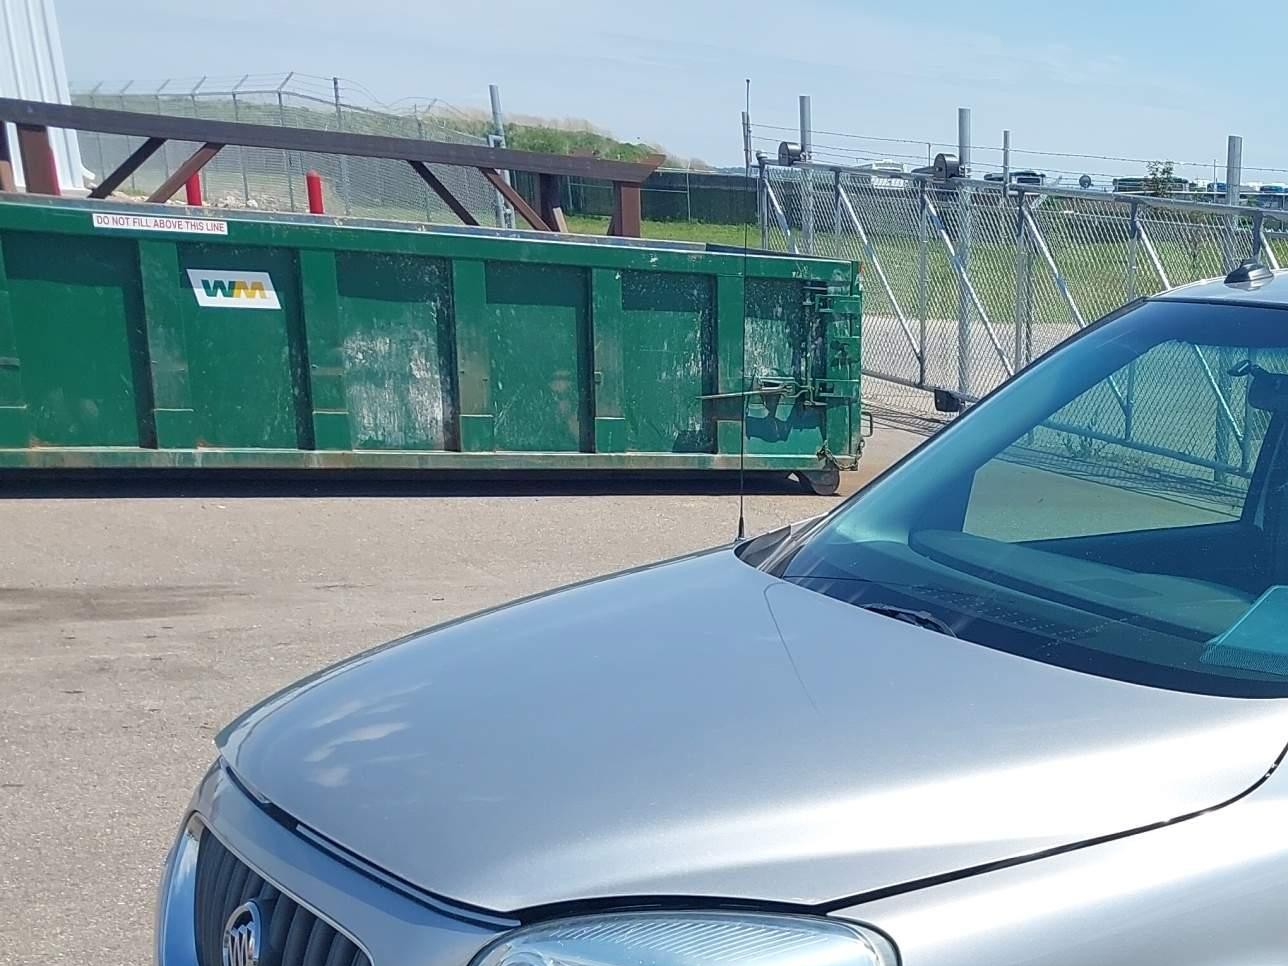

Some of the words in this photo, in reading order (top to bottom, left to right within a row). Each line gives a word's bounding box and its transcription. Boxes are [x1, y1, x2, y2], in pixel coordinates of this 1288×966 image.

[96, 215, 110, 225] DO
[112, 216, 129, 226] NOT
[133, 217, 152, 228] FILL
[153, 219, 185, 230] ABOVE
[185, 221, 204, 231] THIS
[206, 222, 225, 232] LINE
[200, 279, 267, 299] WM
